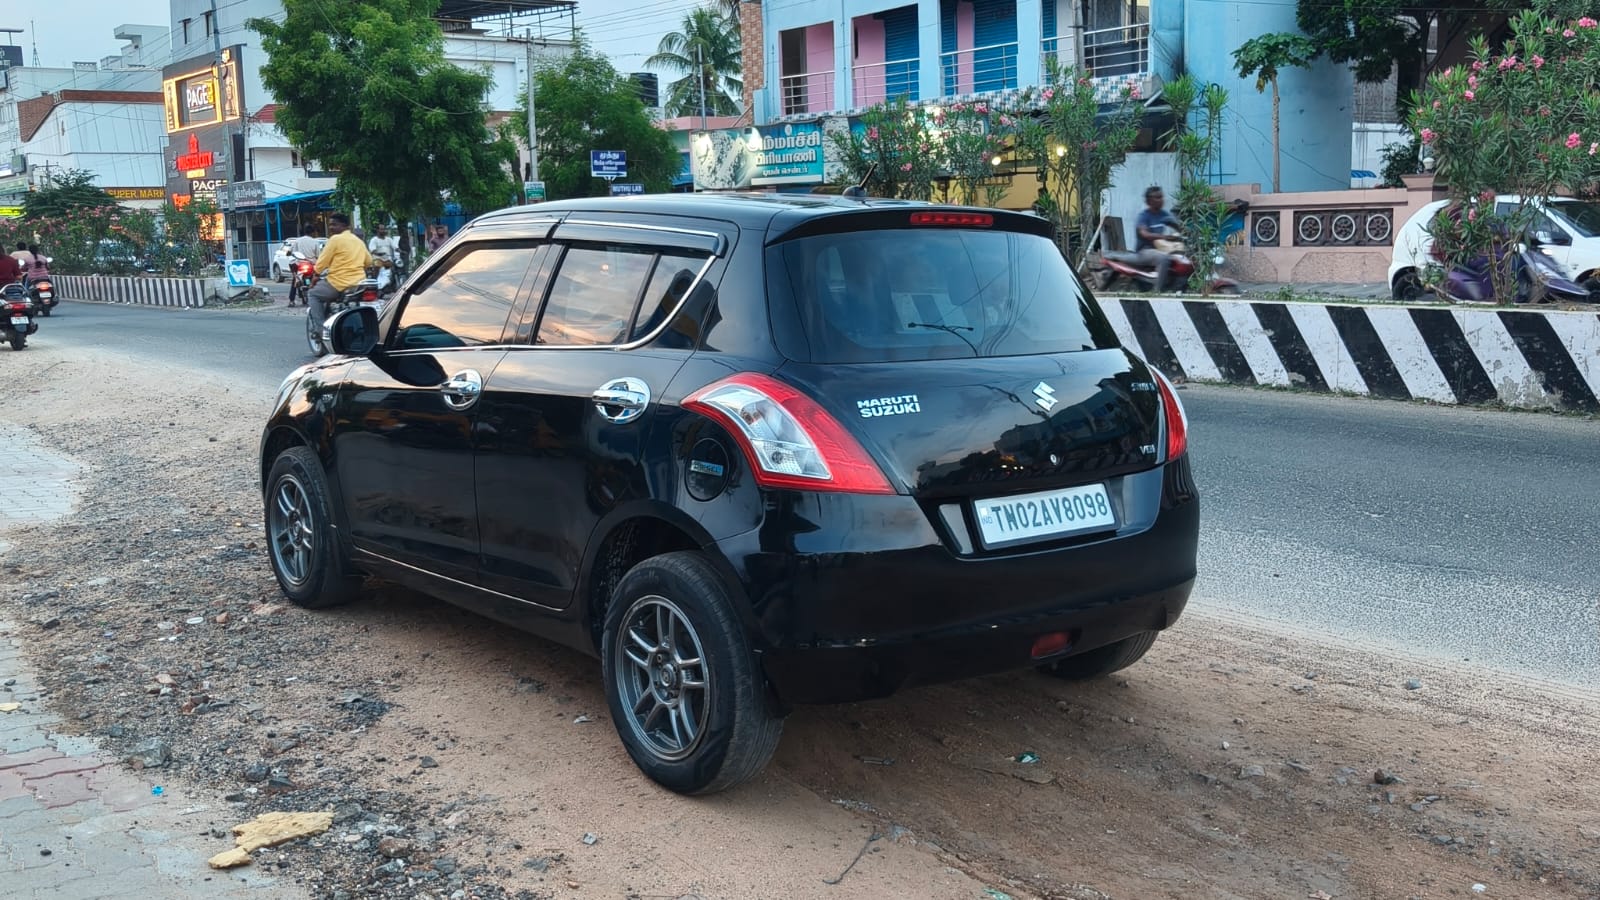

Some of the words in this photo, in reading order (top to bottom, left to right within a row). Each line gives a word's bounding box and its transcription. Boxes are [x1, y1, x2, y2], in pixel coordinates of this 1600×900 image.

[186, 84, 208, 108] PAGE
[857, 394, 919, 408] MARUTI
[860, 402, 921, 418] SUZUKI
[991, 492, 1108, 532] TN02AV8098
